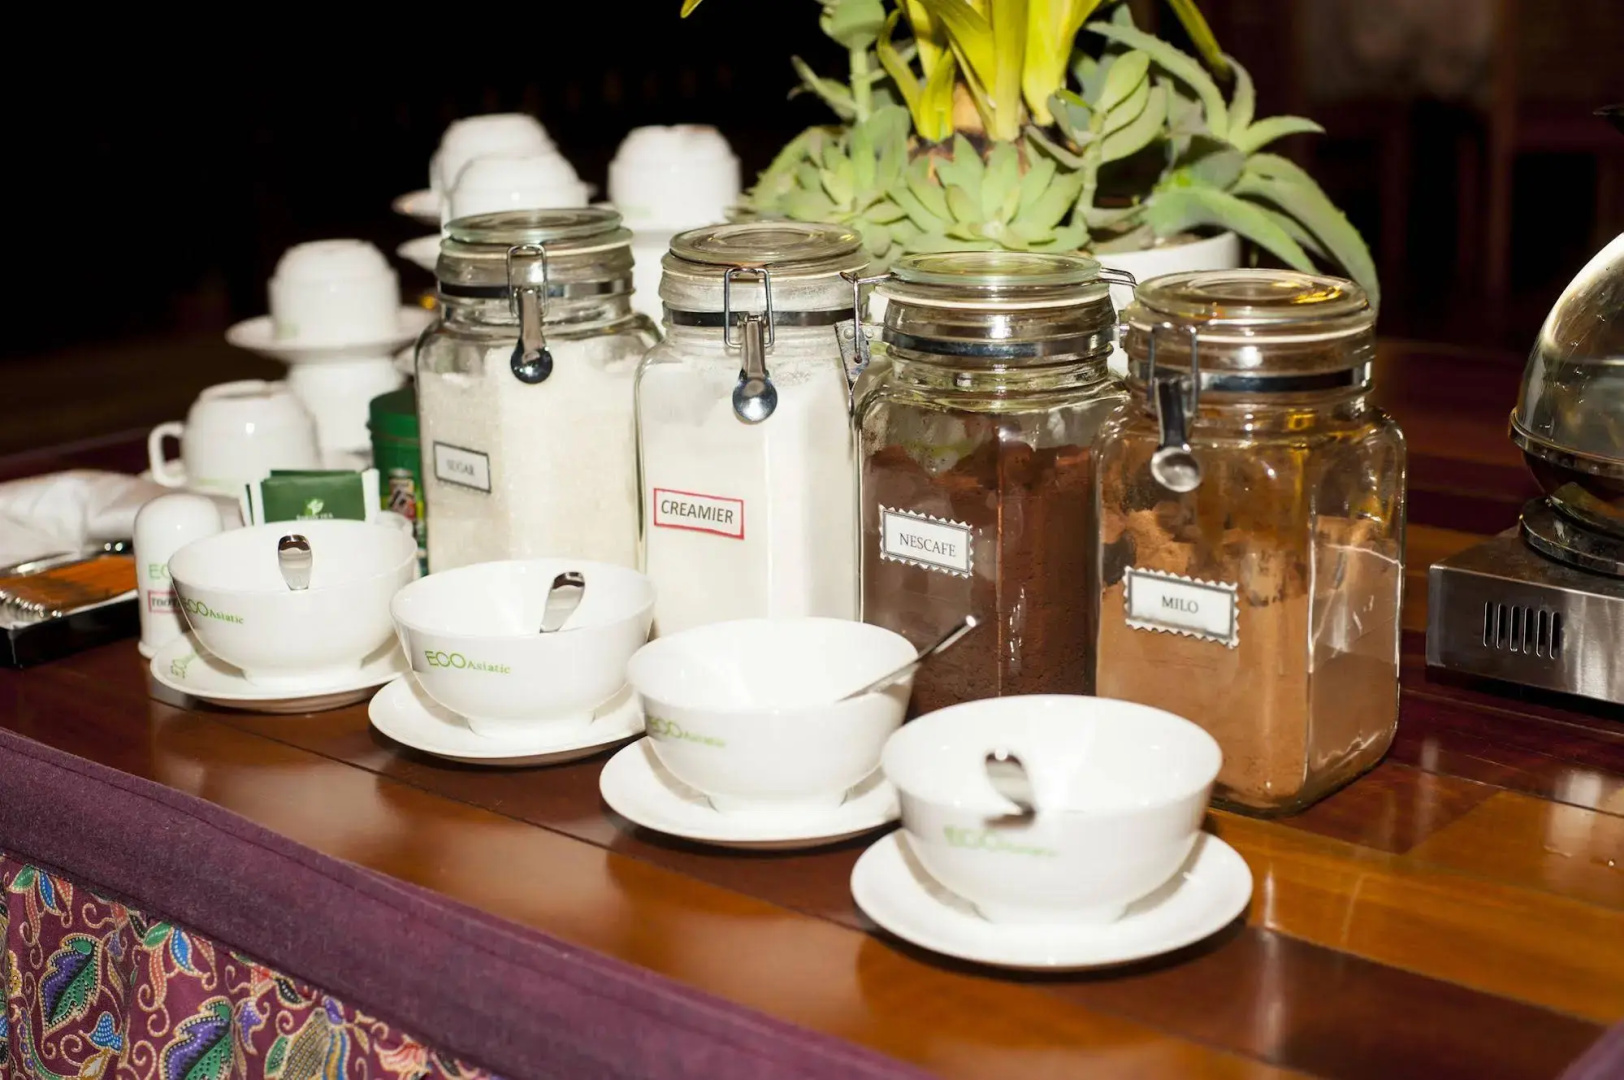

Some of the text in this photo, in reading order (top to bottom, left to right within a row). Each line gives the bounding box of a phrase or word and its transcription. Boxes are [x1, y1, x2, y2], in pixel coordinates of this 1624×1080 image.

[661, 499, 734, 524] CREAMIER
[899, 532, 957, 558] NESCAFE
[1161, 594, 1199, 614] MILO
[424, 650, 511, 675] ECO Asiatic
